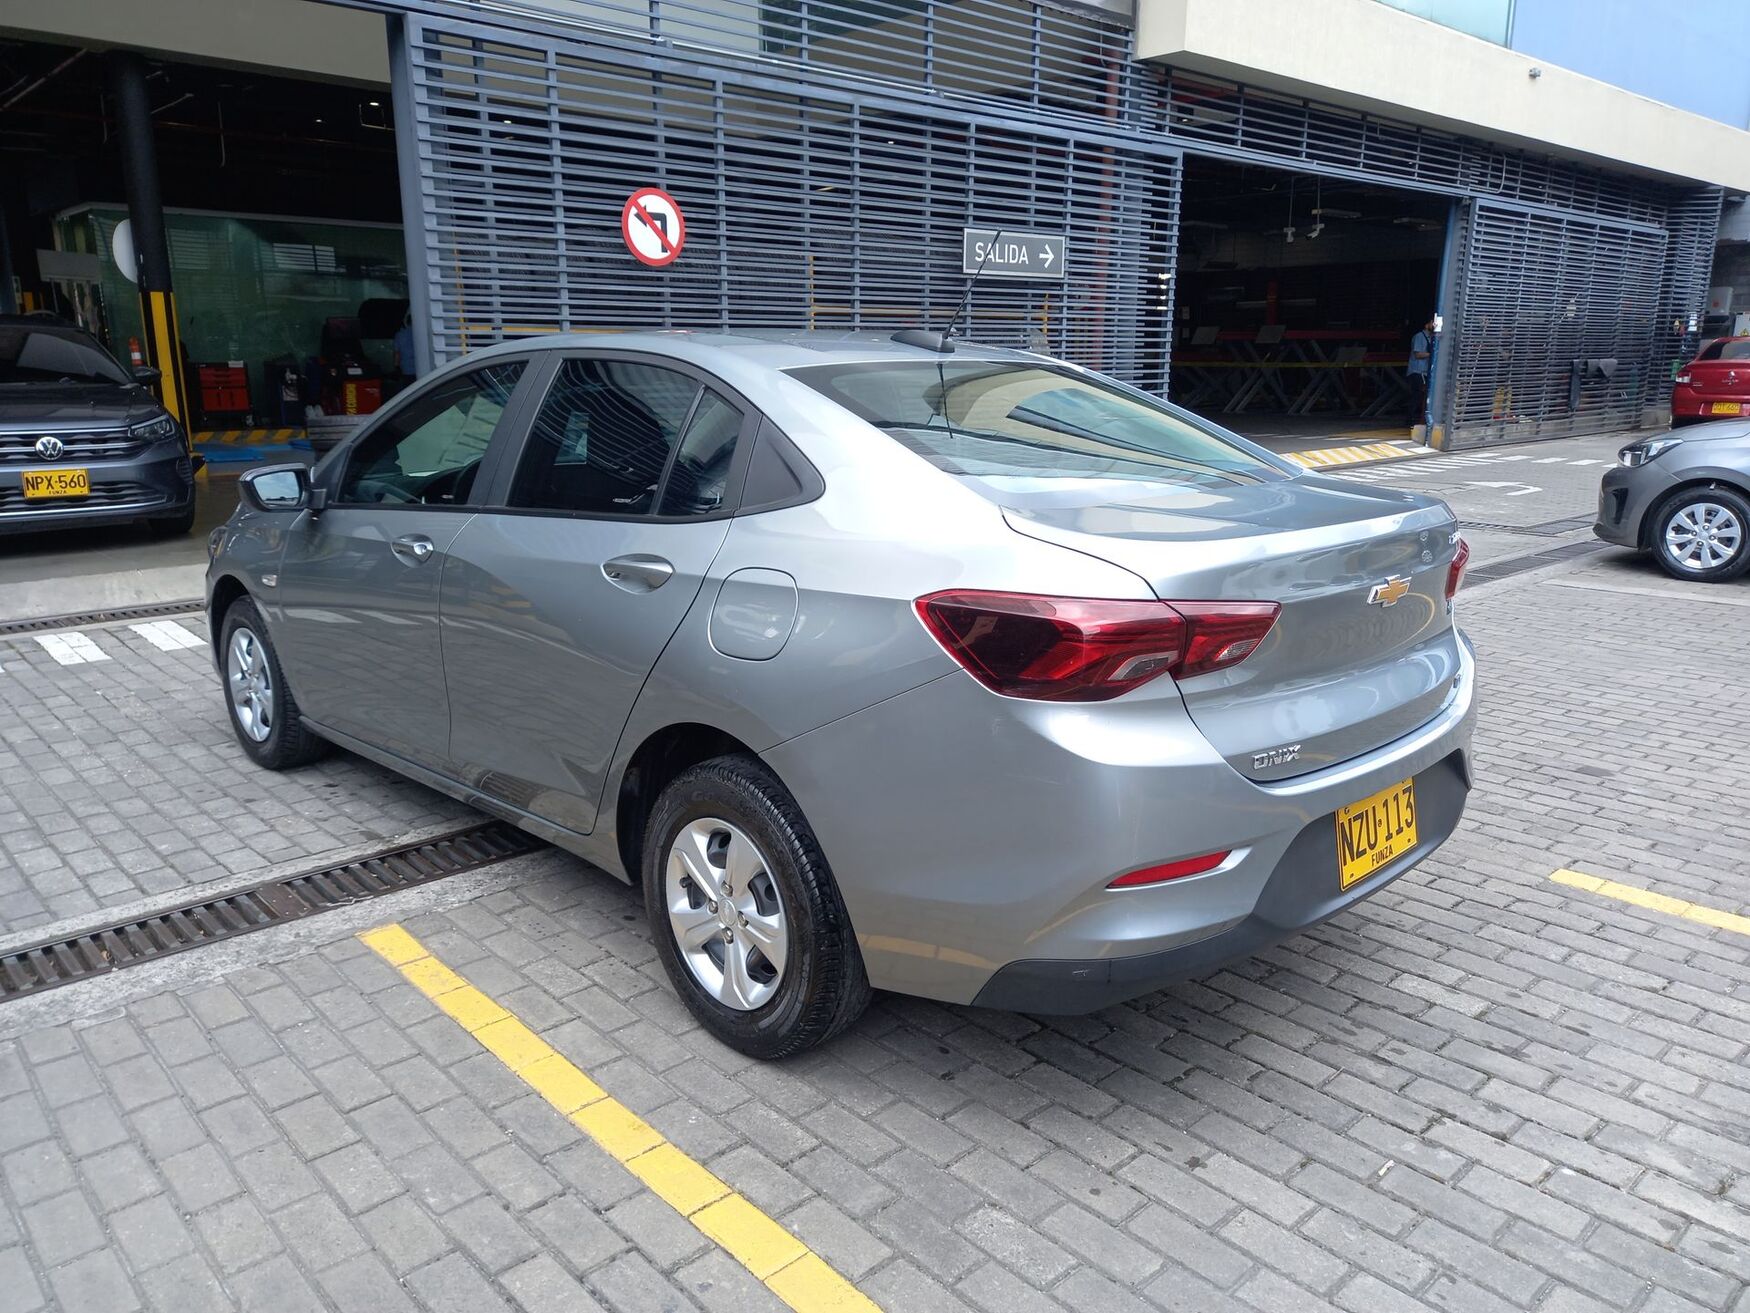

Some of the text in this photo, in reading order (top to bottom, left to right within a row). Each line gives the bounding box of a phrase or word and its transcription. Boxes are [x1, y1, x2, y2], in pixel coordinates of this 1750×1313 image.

[975, 242, 1029, 264] SALIDA
[1252, 745, 1301, 769] ONIX
[1371, 844, 1393, 866] FUNZA
